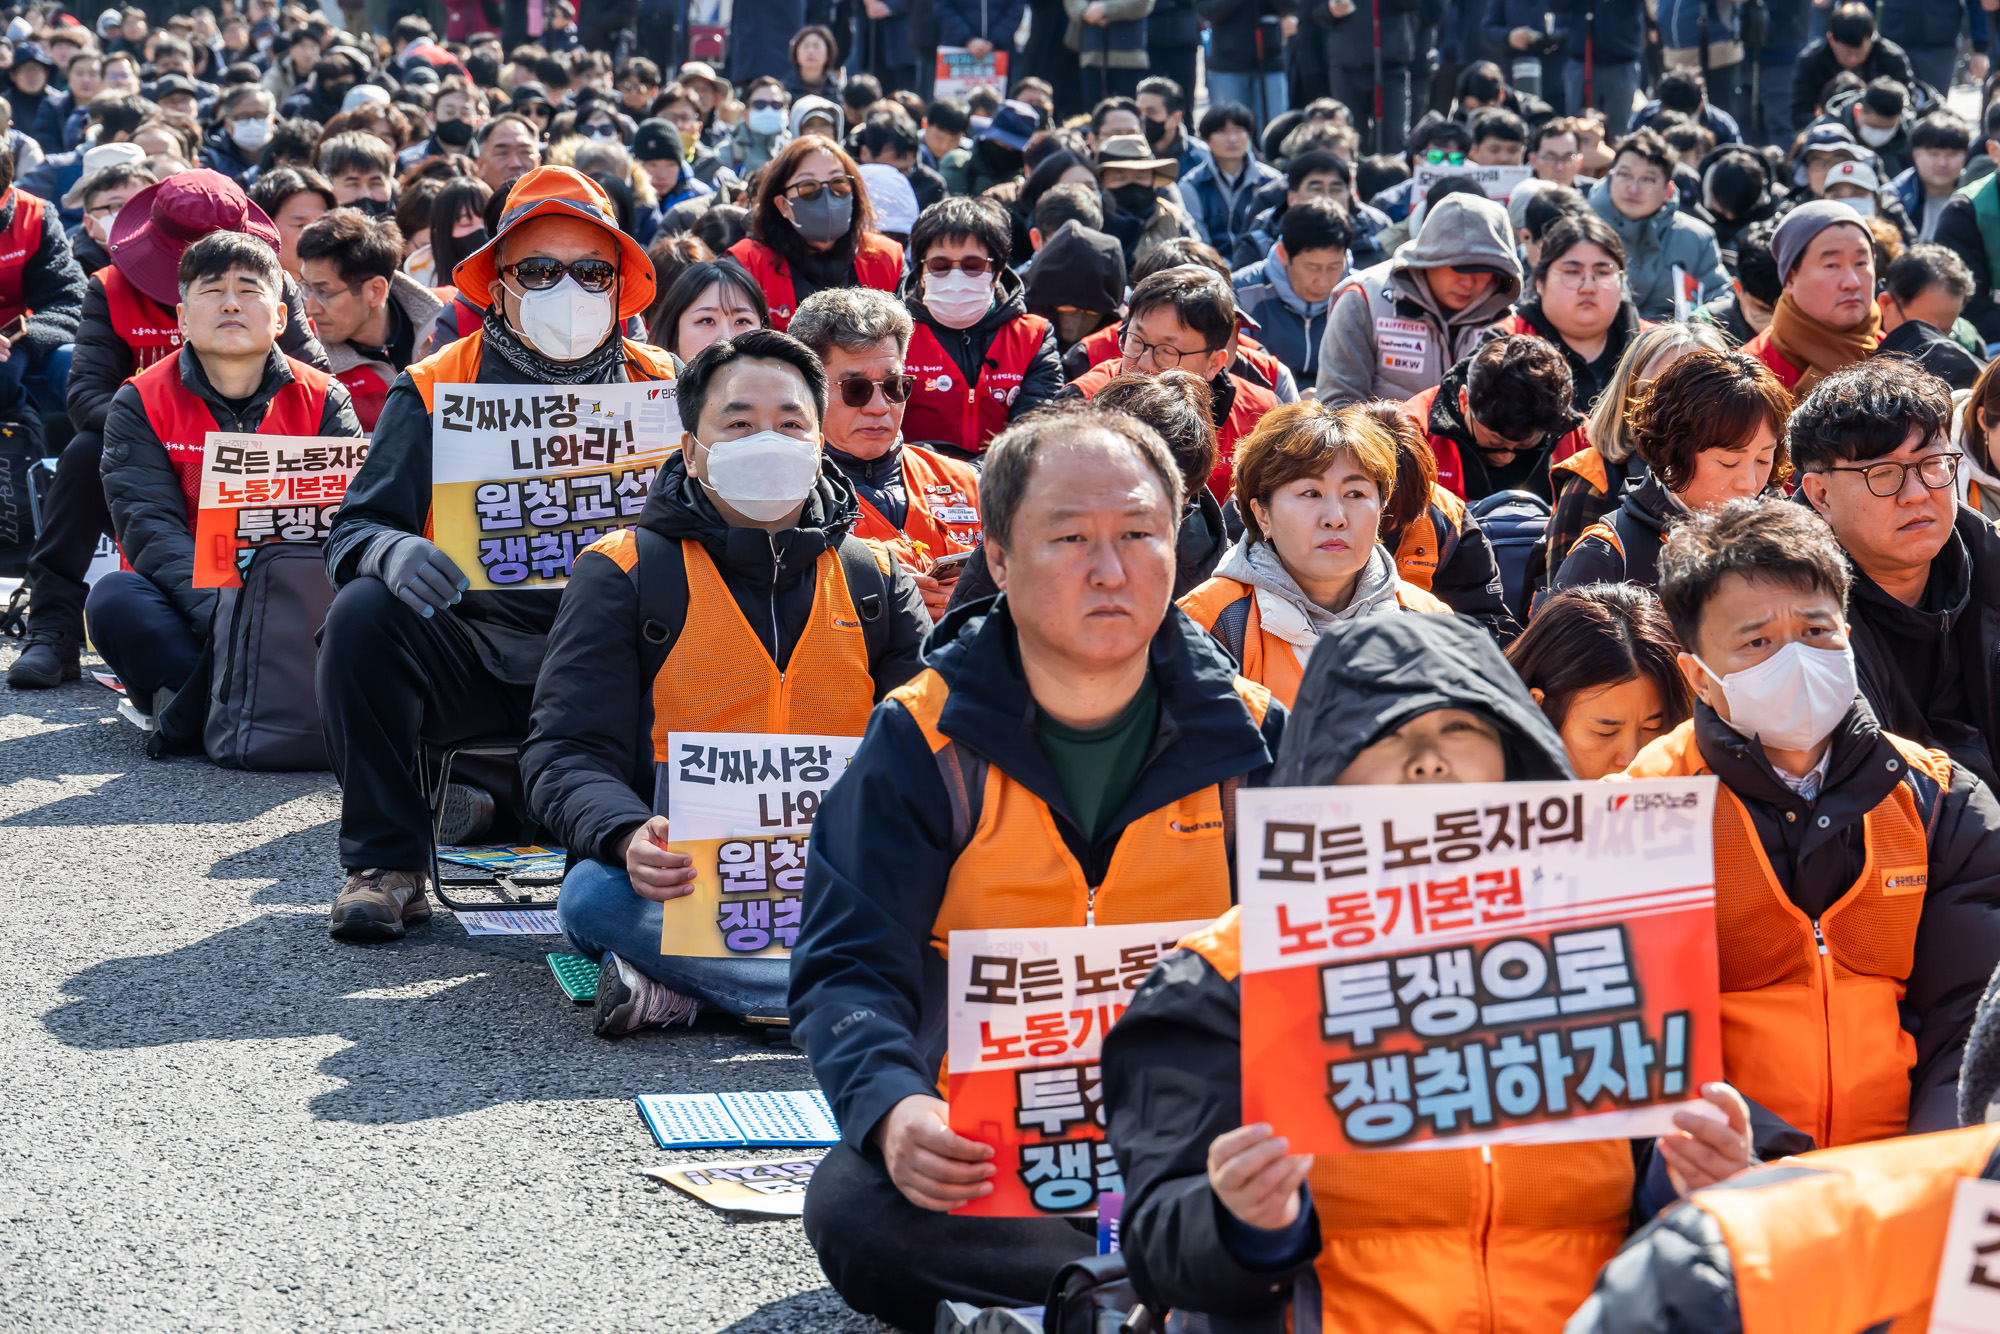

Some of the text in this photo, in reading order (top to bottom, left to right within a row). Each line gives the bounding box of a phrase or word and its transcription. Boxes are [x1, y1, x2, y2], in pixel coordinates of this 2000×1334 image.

[1378, 320, 1427, 333] RAIFFEISEN
[1394, 358, 1420, 369] BKW
[442, 394, 580, 433] 진짜사장
[211, 445, 270, 475] 모든
[511, 420, 636, 471] 나와라!
[218, 474, 347, 504] 노동기본권
[475, 466, 657, 532] 원청교섭
[679, 743, 832, 786] 진짜사장
[1633, 792, 1699, 812] 민주노총
[1257, 820, 1369, 883] 모든
[1382, 794, 1585, 871] 노동자의
[1275, 867, 1526, 957] 노동기본권
[965, 940, 1181, 1005] 모든 노동
[1319, 922, 1644, 1051] 투쟁으로
[1326, 1009, 1693, 1149] 쟁취하자!
